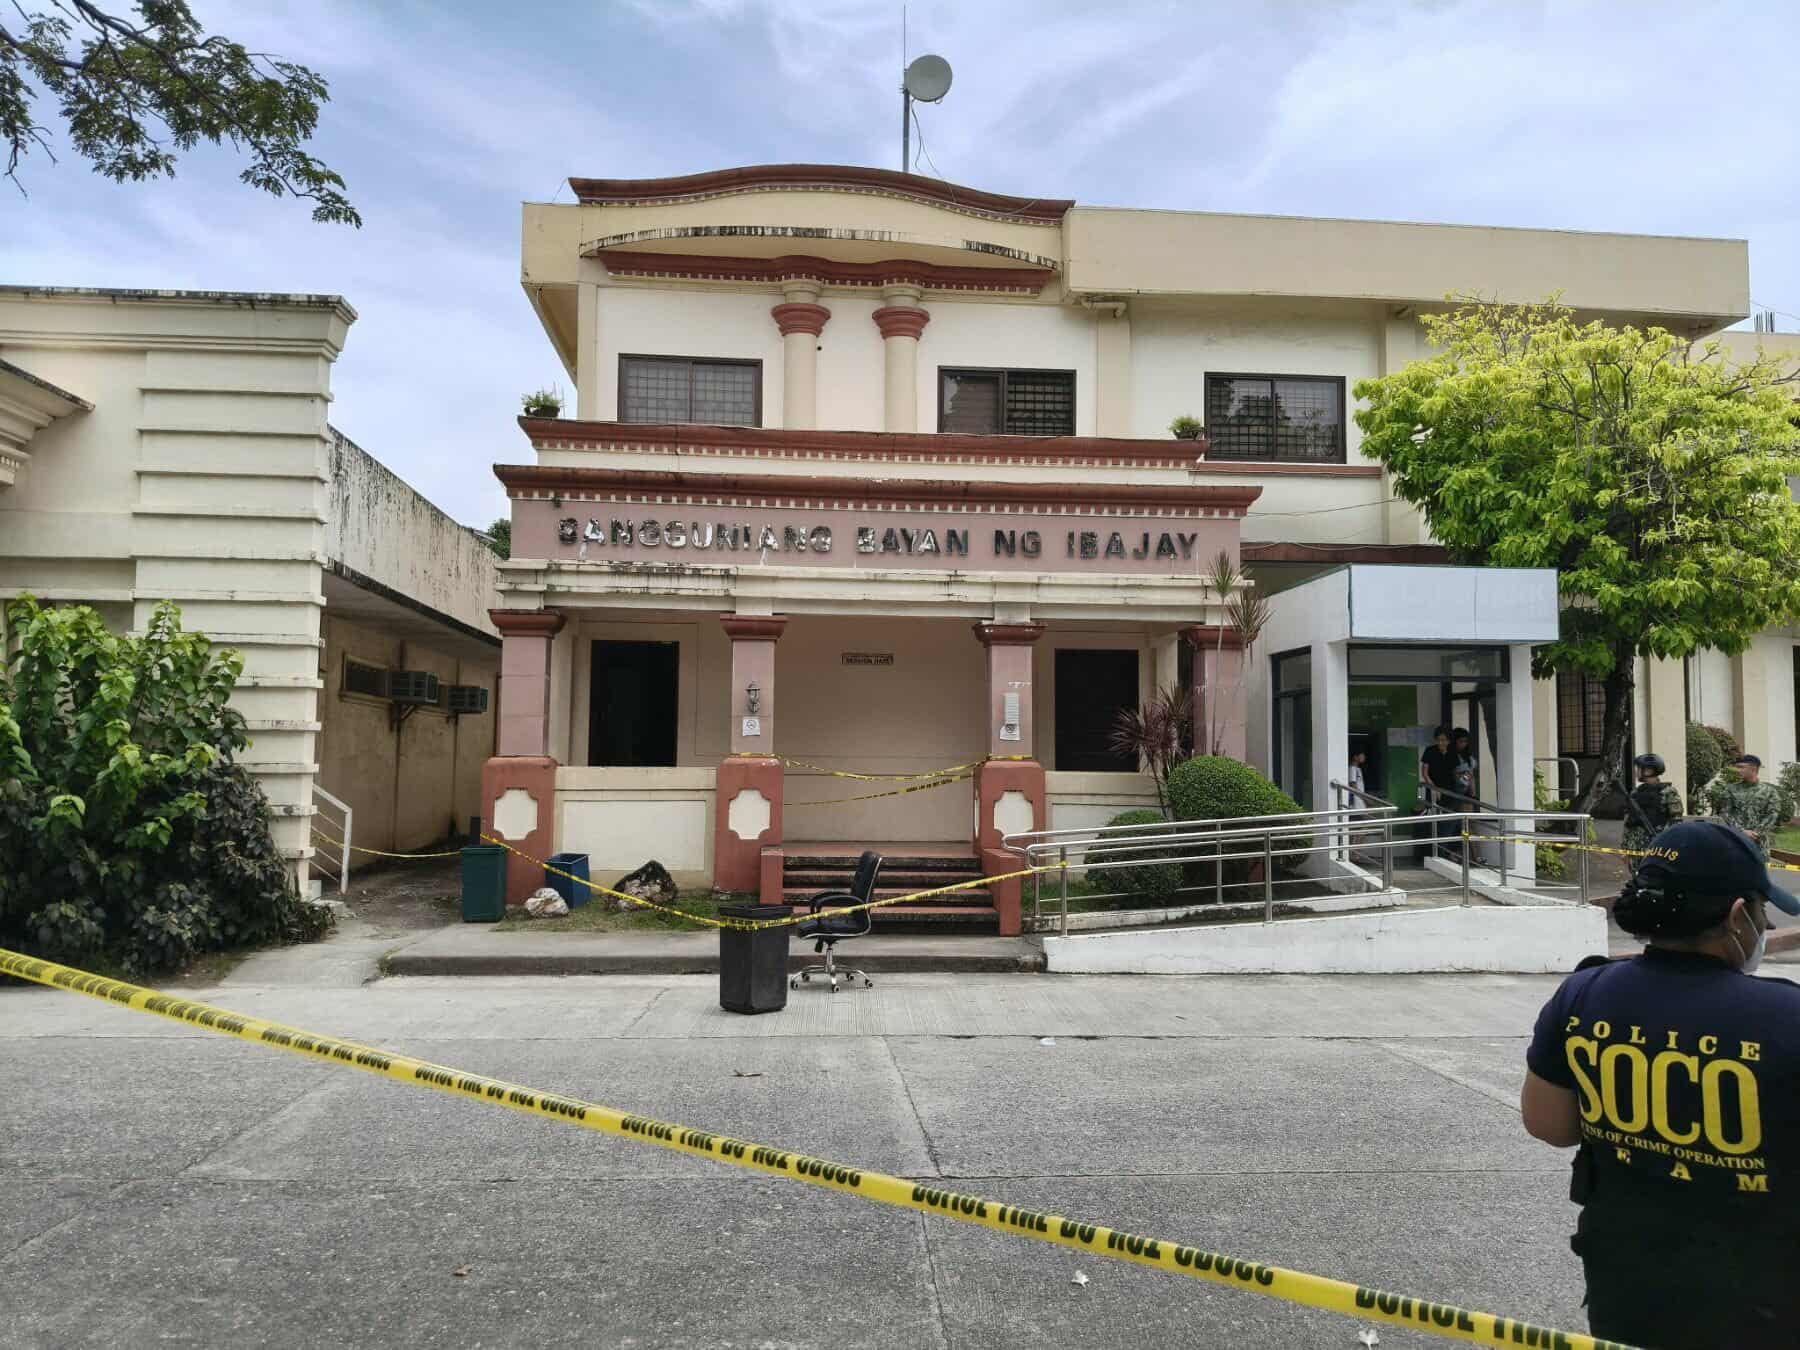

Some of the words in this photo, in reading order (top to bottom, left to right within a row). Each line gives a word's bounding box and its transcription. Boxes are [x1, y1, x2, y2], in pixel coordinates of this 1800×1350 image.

[856, 526, 970, 557] BAYAN
[994, 529, 1043, 559] NG
[1066, 530, 1199, 561] IBAJAY
[1565, 1016, 1761, 1062] POLICE
[1564, 1034, 1762, 1156] SOCO
[1606, 1130, 1623, 1144] OF
[1624, 1135, 1671, 1155] CRIME
[1673, 1145, 1765, 1170] OPERATION
[1615, 1147, 1770, 1193] EAM
